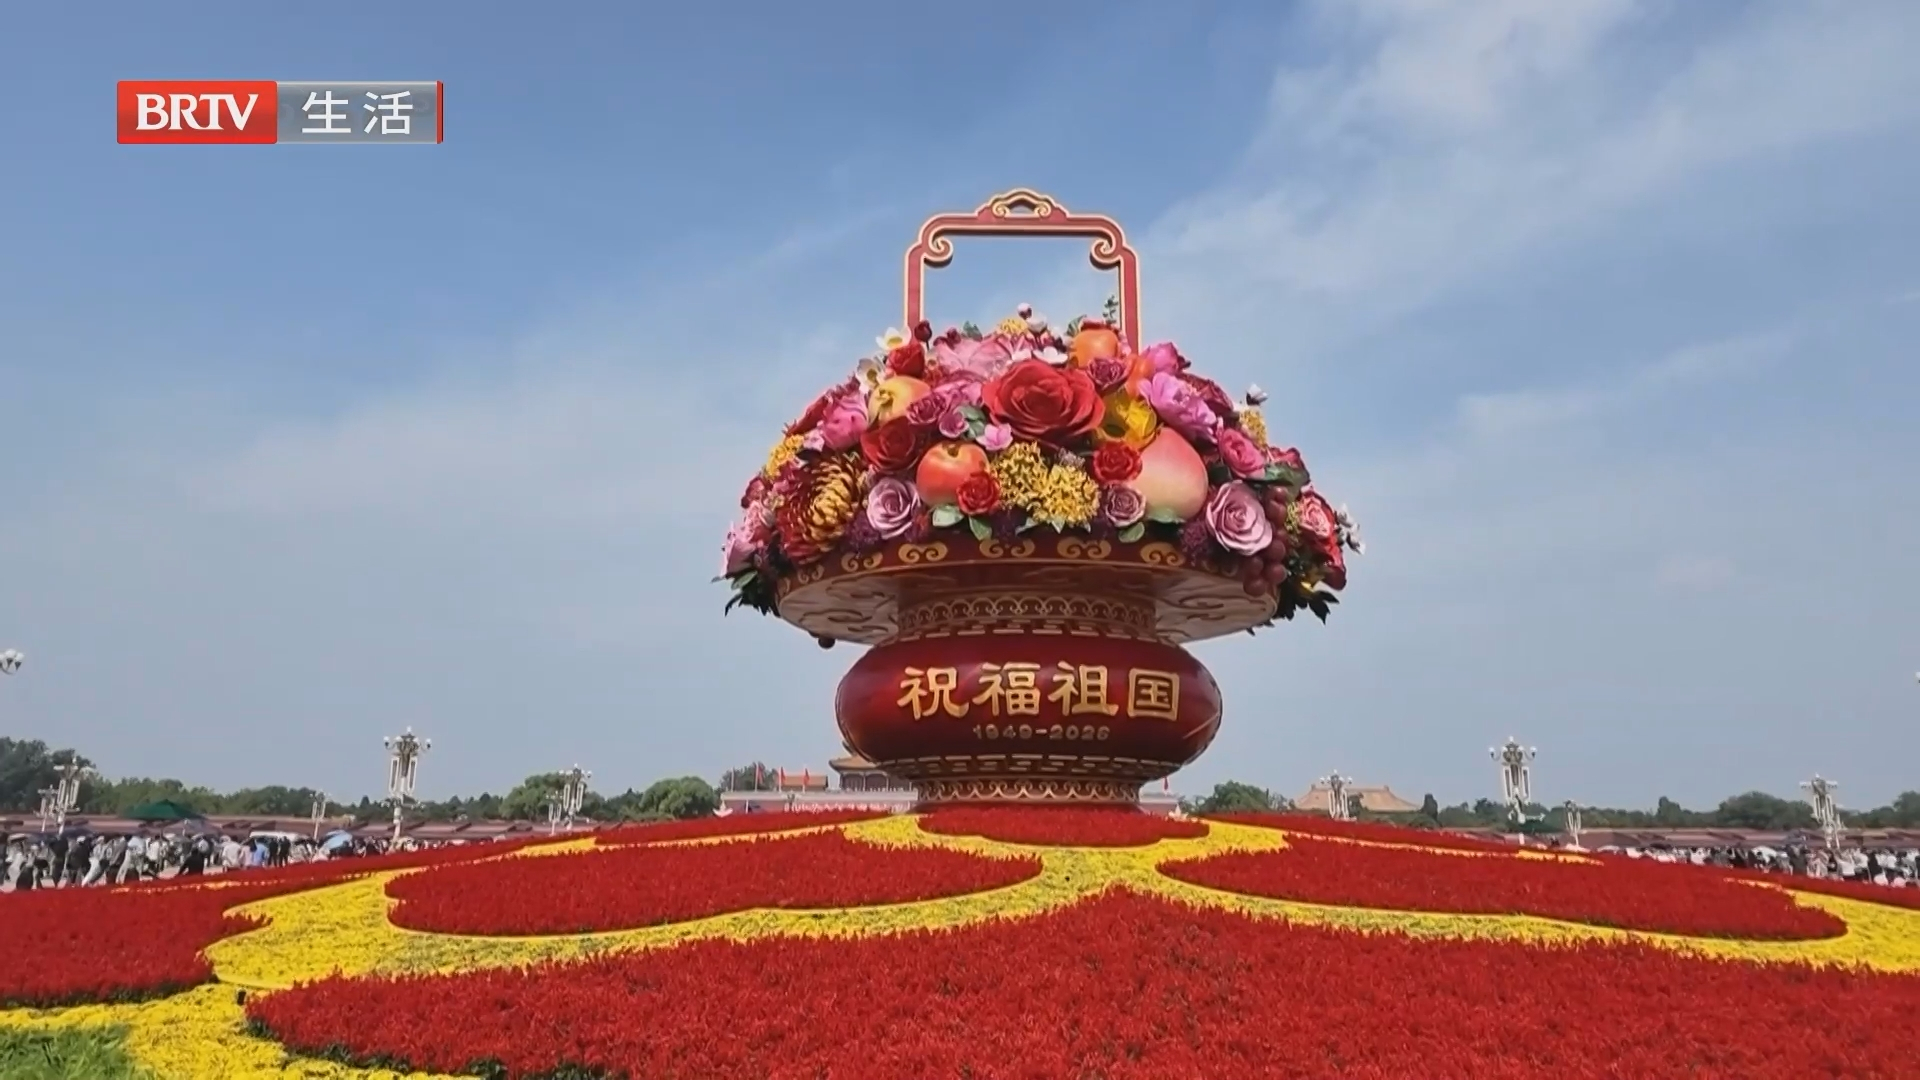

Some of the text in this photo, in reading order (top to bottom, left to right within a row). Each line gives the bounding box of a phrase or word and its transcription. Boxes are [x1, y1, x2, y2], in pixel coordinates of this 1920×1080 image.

[896, 660, 1181, 722] 祝福祖国
[972, 723, 1111, 741] 1949-2026
